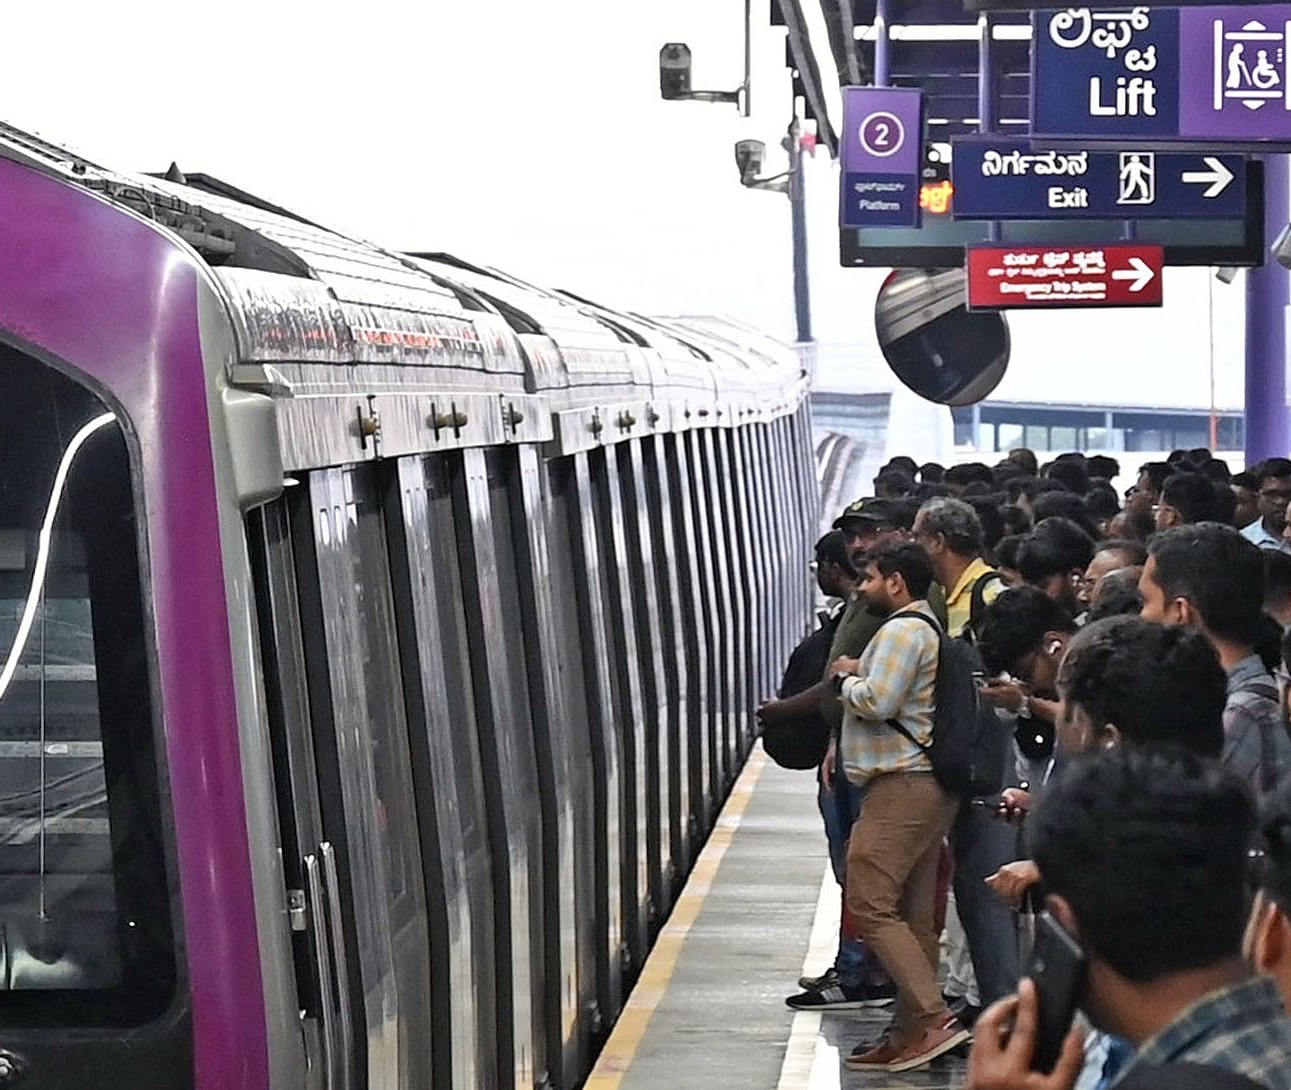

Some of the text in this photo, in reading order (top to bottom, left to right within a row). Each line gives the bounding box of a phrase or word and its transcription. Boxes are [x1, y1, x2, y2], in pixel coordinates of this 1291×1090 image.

[1090, 77, 1157, 115] Lift
[874, 123, 889, 145] 2
[981, 150, 1088, 176] ನಿರ್ಗಮನ
[859, 198, 901, 211] Platform
[1048, 187, 1089, 208] Exit
[999, 280, 1107, 294] Emergency Trip System
